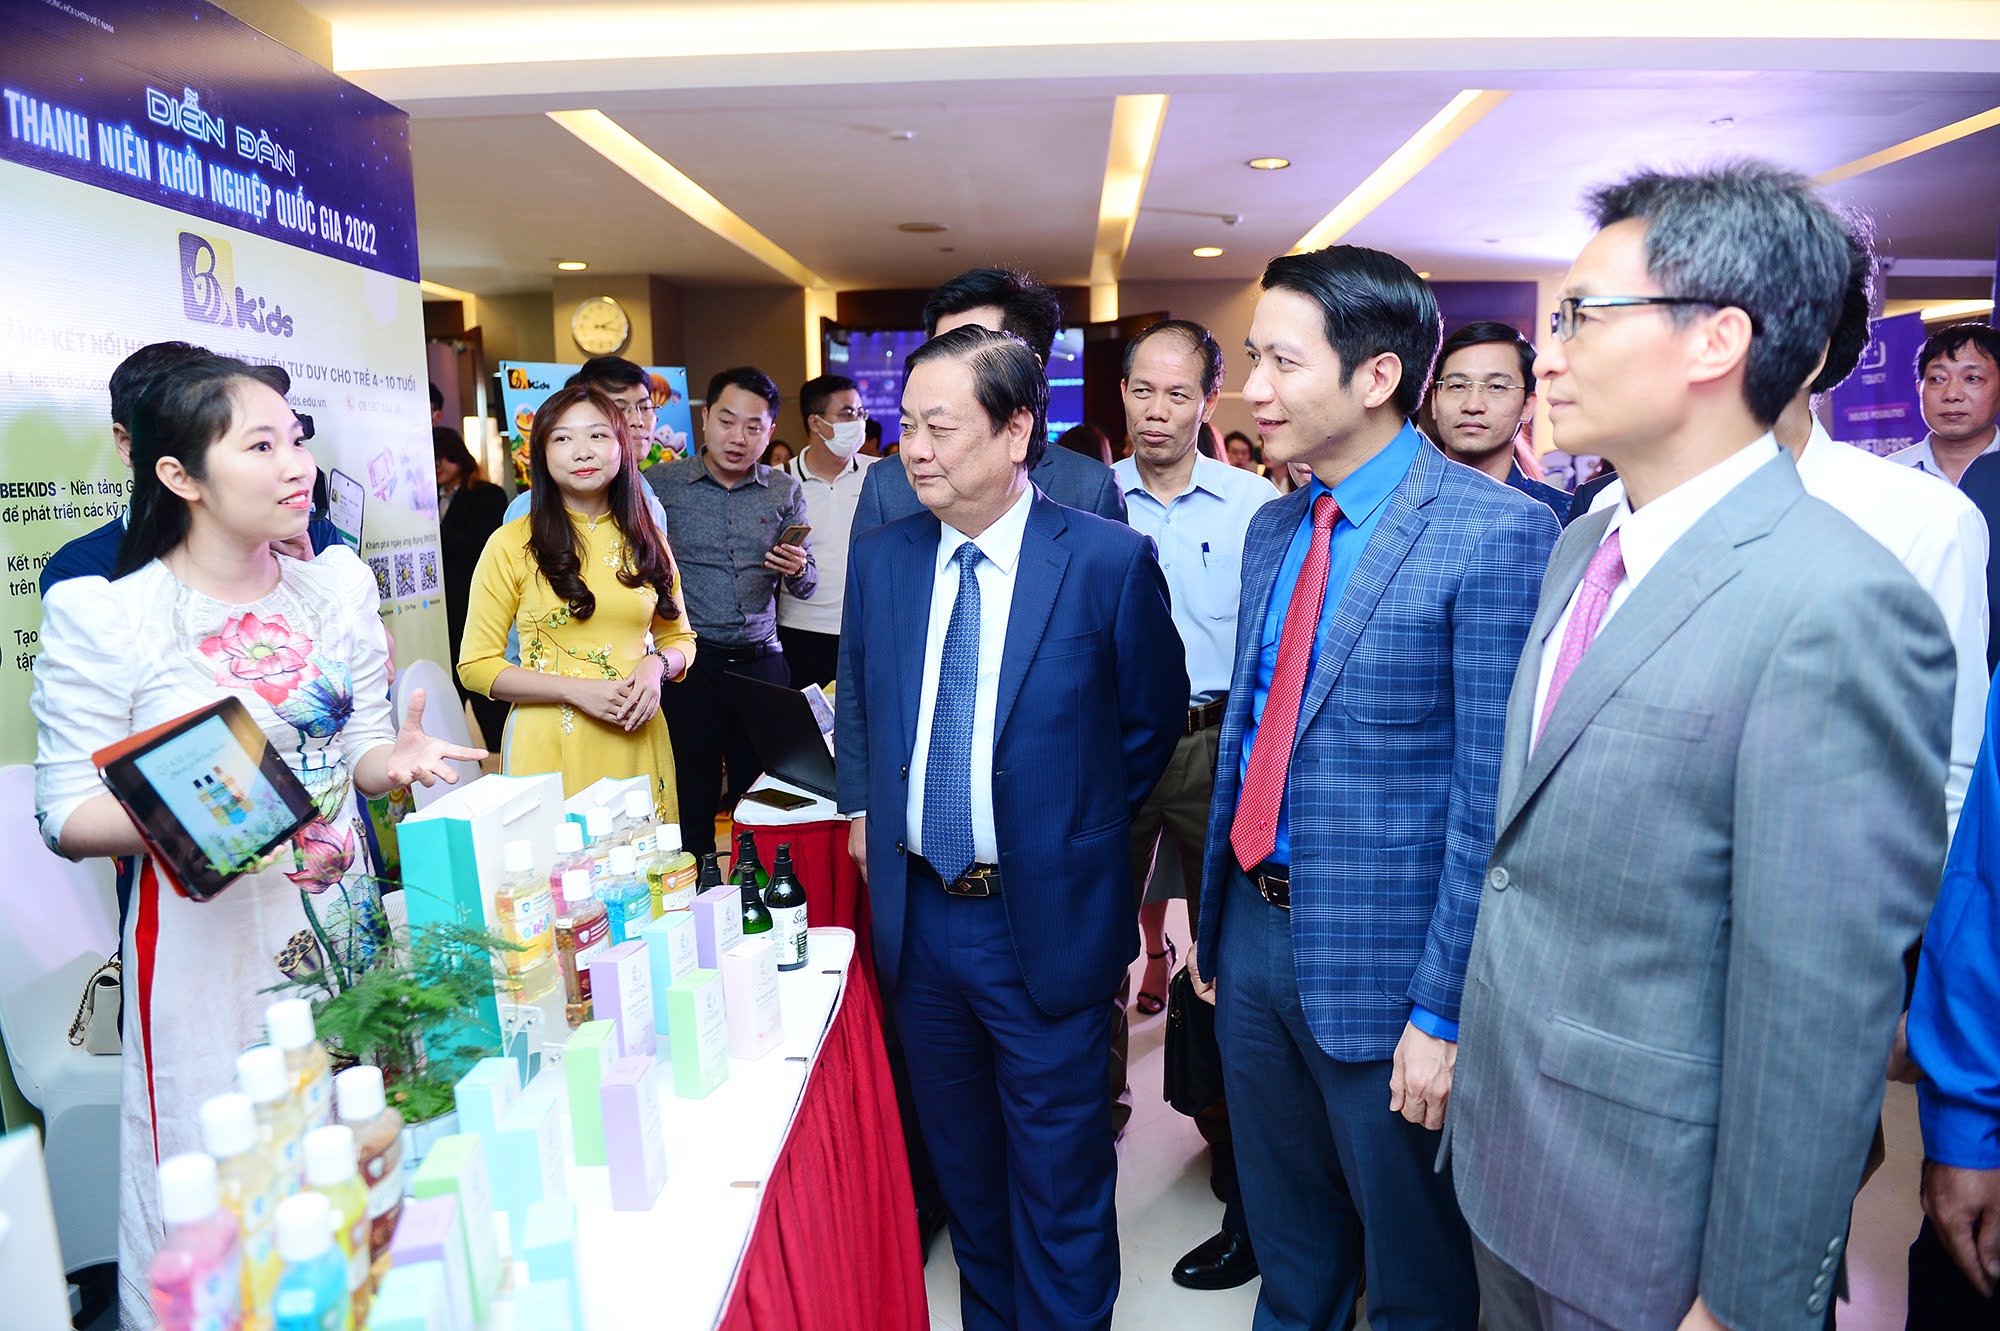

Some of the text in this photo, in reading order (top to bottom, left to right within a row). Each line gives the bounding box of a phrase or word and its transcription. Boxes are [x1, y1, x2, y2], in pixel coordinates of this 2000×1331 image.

[101, 21, 115, 33] NAM
[146, 86, 296, 177] DIỄN ĐÀN
[3, 88, 377, 256] THANH NIÊN KHỞI NGHIỆP QUỐC GIA 2022
[92, 330, 121, 356] NỐI
[288, 361, 304, 378] TƯ
[306, 364, 327, 382] DUY
[330, 368, 351, 384] CHO
[353, 368, 370, 387] TRẺ
[372, 374, 378, 387] 4
[385, 376, 395, 389] 10
[285, 394, 327, 408] kids.edu.vn
[0, 481, 57, 498] BEEKIDS
[70, 479, 94, 496] Nền
[97, 478, 123, 497] tảng
[3, 505, 19, 523] để
[22, 505, 51, 526] phát
[53, 502, 81, 520] triển
[83, 502, 104, 518] các
[106, 502, 119, 519] kỹ
[7, 553, 30, 572] Kết
[10, 578, 36, 596] trên
[14, 629, 38, 648] Tạo
